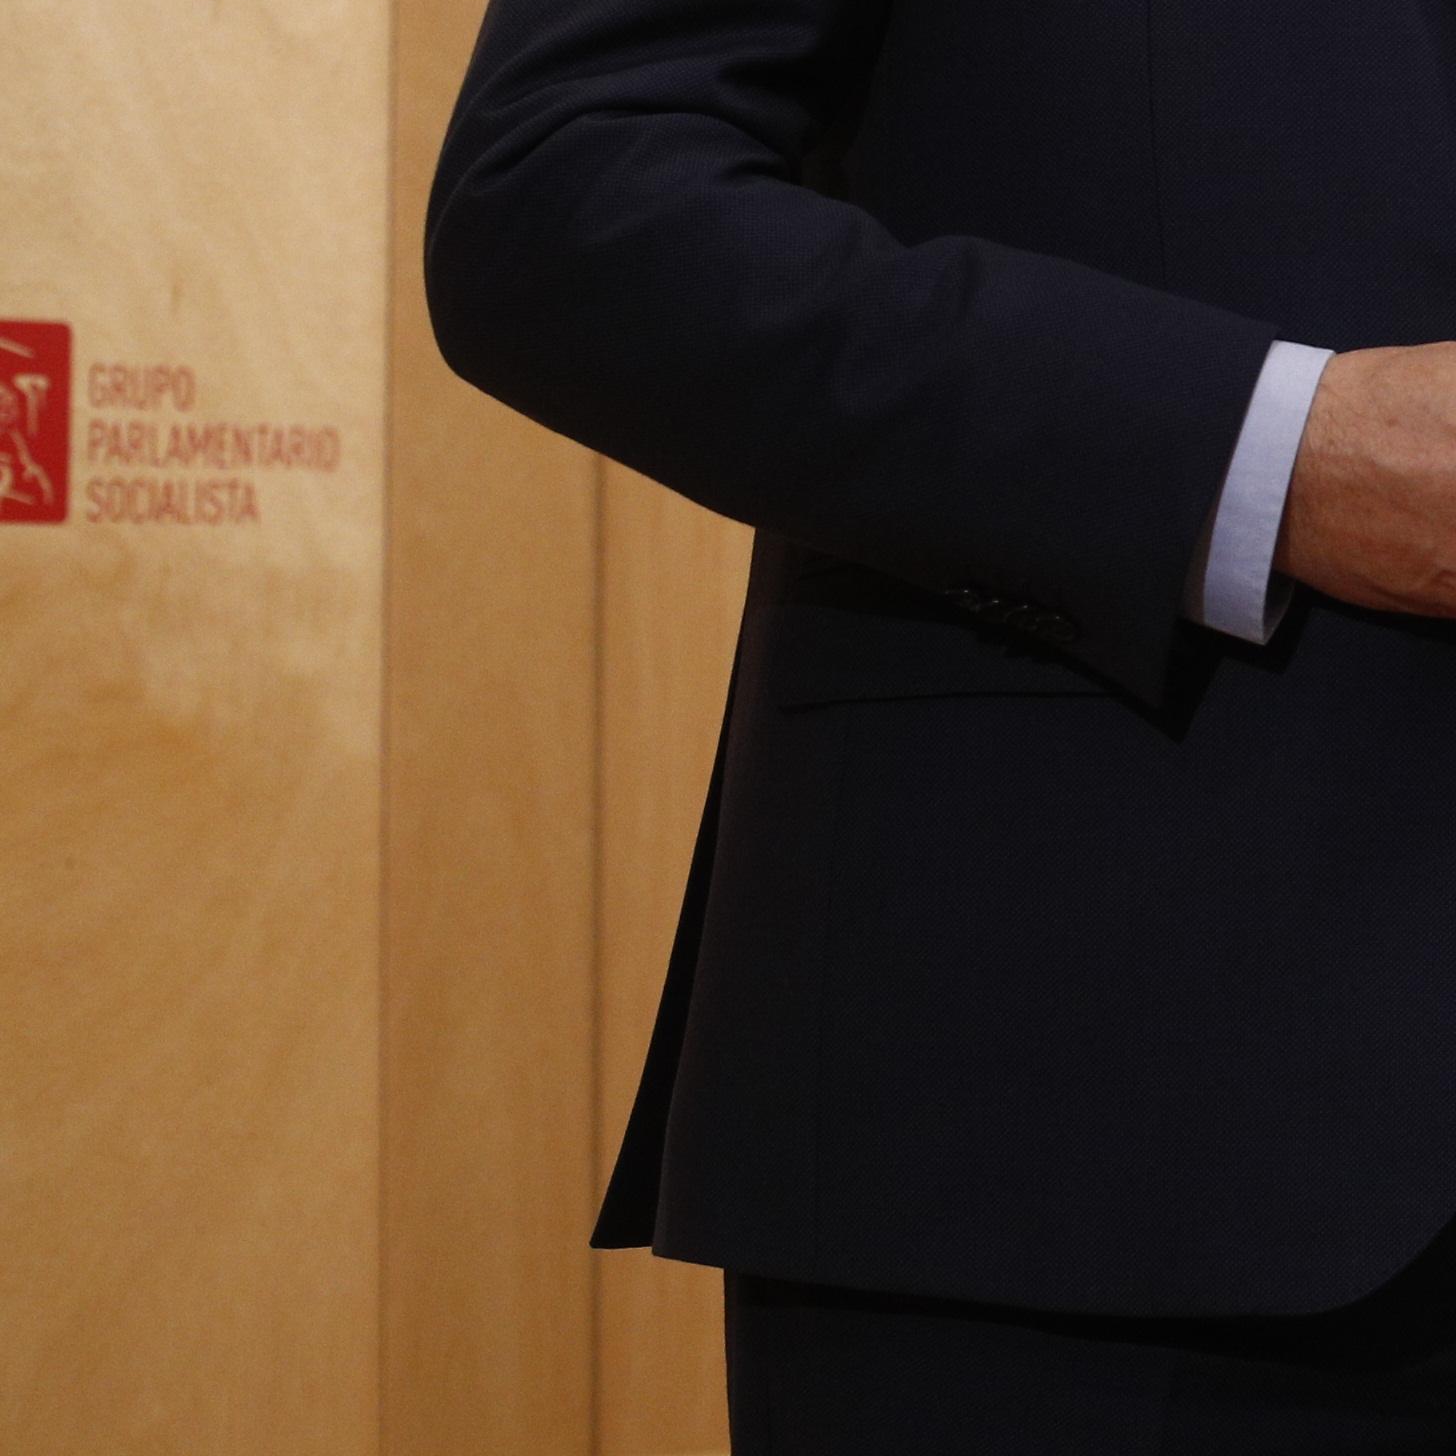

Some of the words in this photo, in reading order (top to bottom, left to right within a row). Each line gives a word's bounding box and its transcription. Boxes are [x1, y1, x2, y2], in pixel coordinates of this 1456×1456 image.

[89, 362, 196, 412] GRUPO
[88, 419, 340, 473] PARLAMENTARIO
[86, 477, 260, 525] SOCIALISTA
